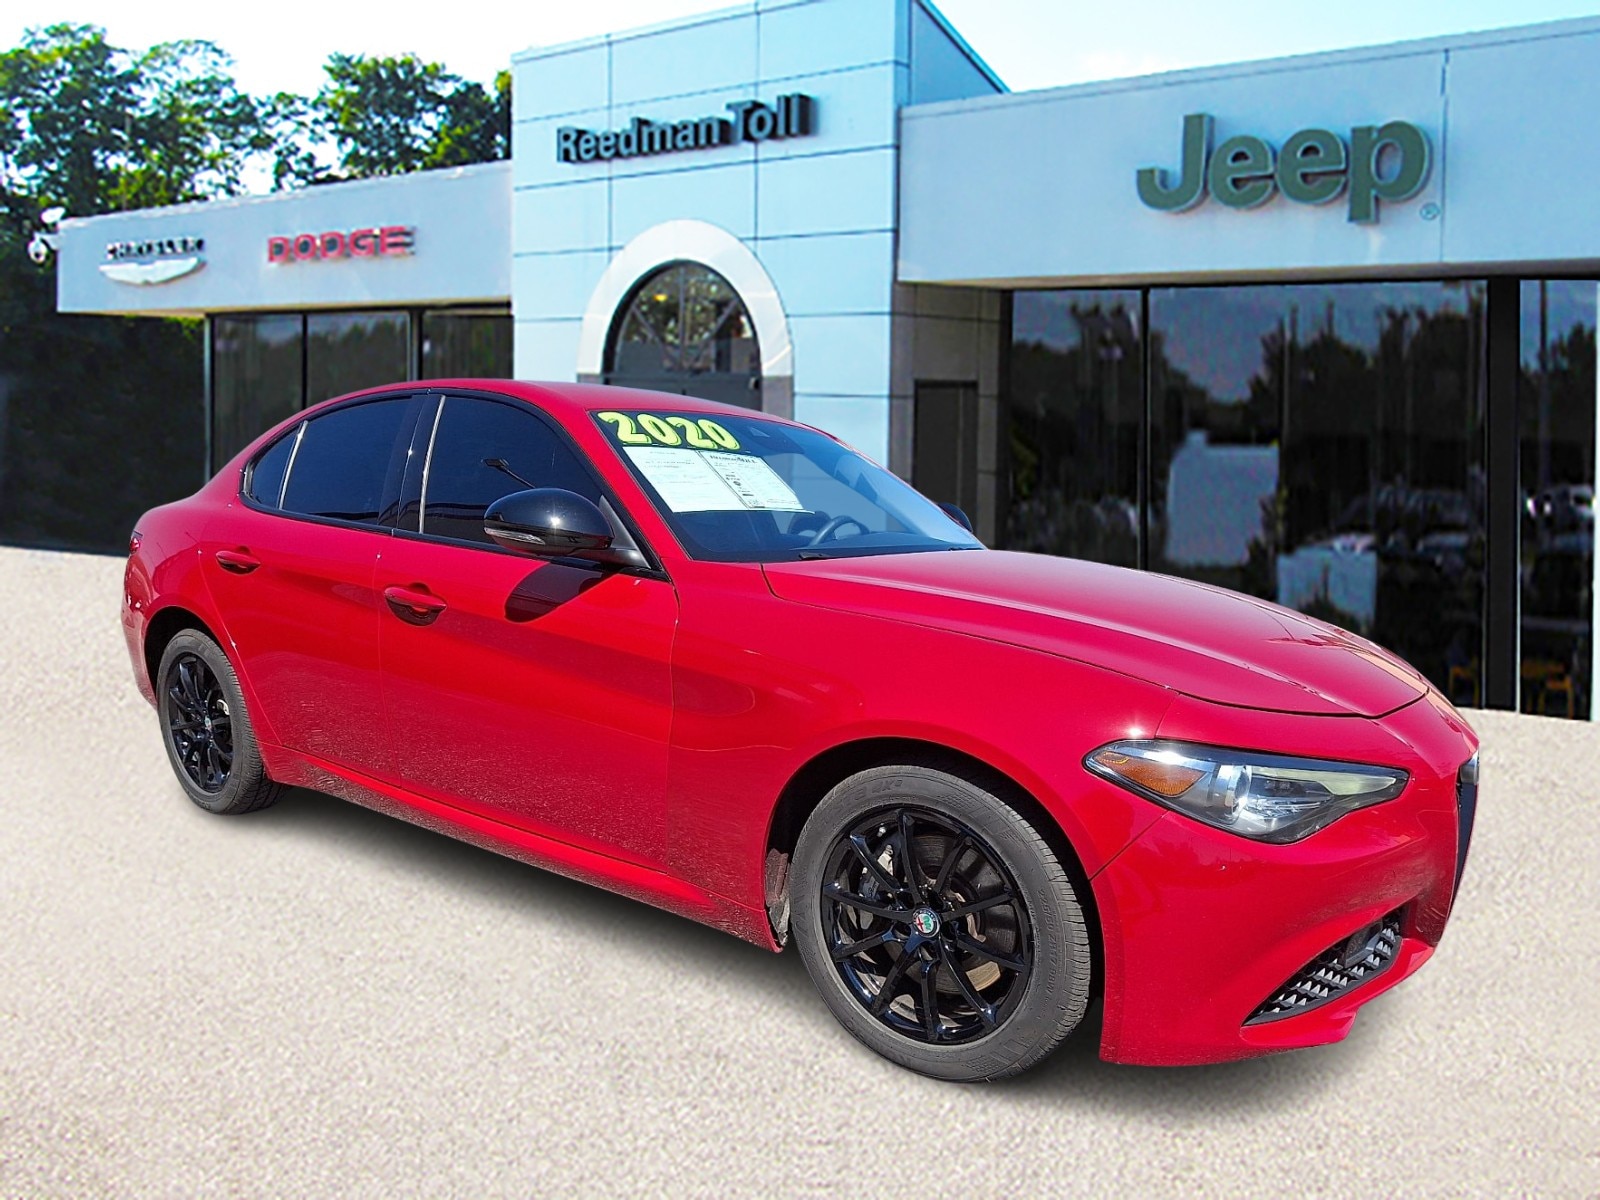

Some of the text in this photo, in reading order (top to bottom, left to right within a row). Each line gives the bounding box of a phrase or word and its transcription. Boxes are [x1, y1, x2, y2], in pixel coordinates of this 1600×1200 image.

[557, 93, 816, 163] Reedman Toll
[1136, 113, 1432, 224] Jeep
[267, 226, 415, 262] DODGE
[597, 411, 741, 451] 2020
